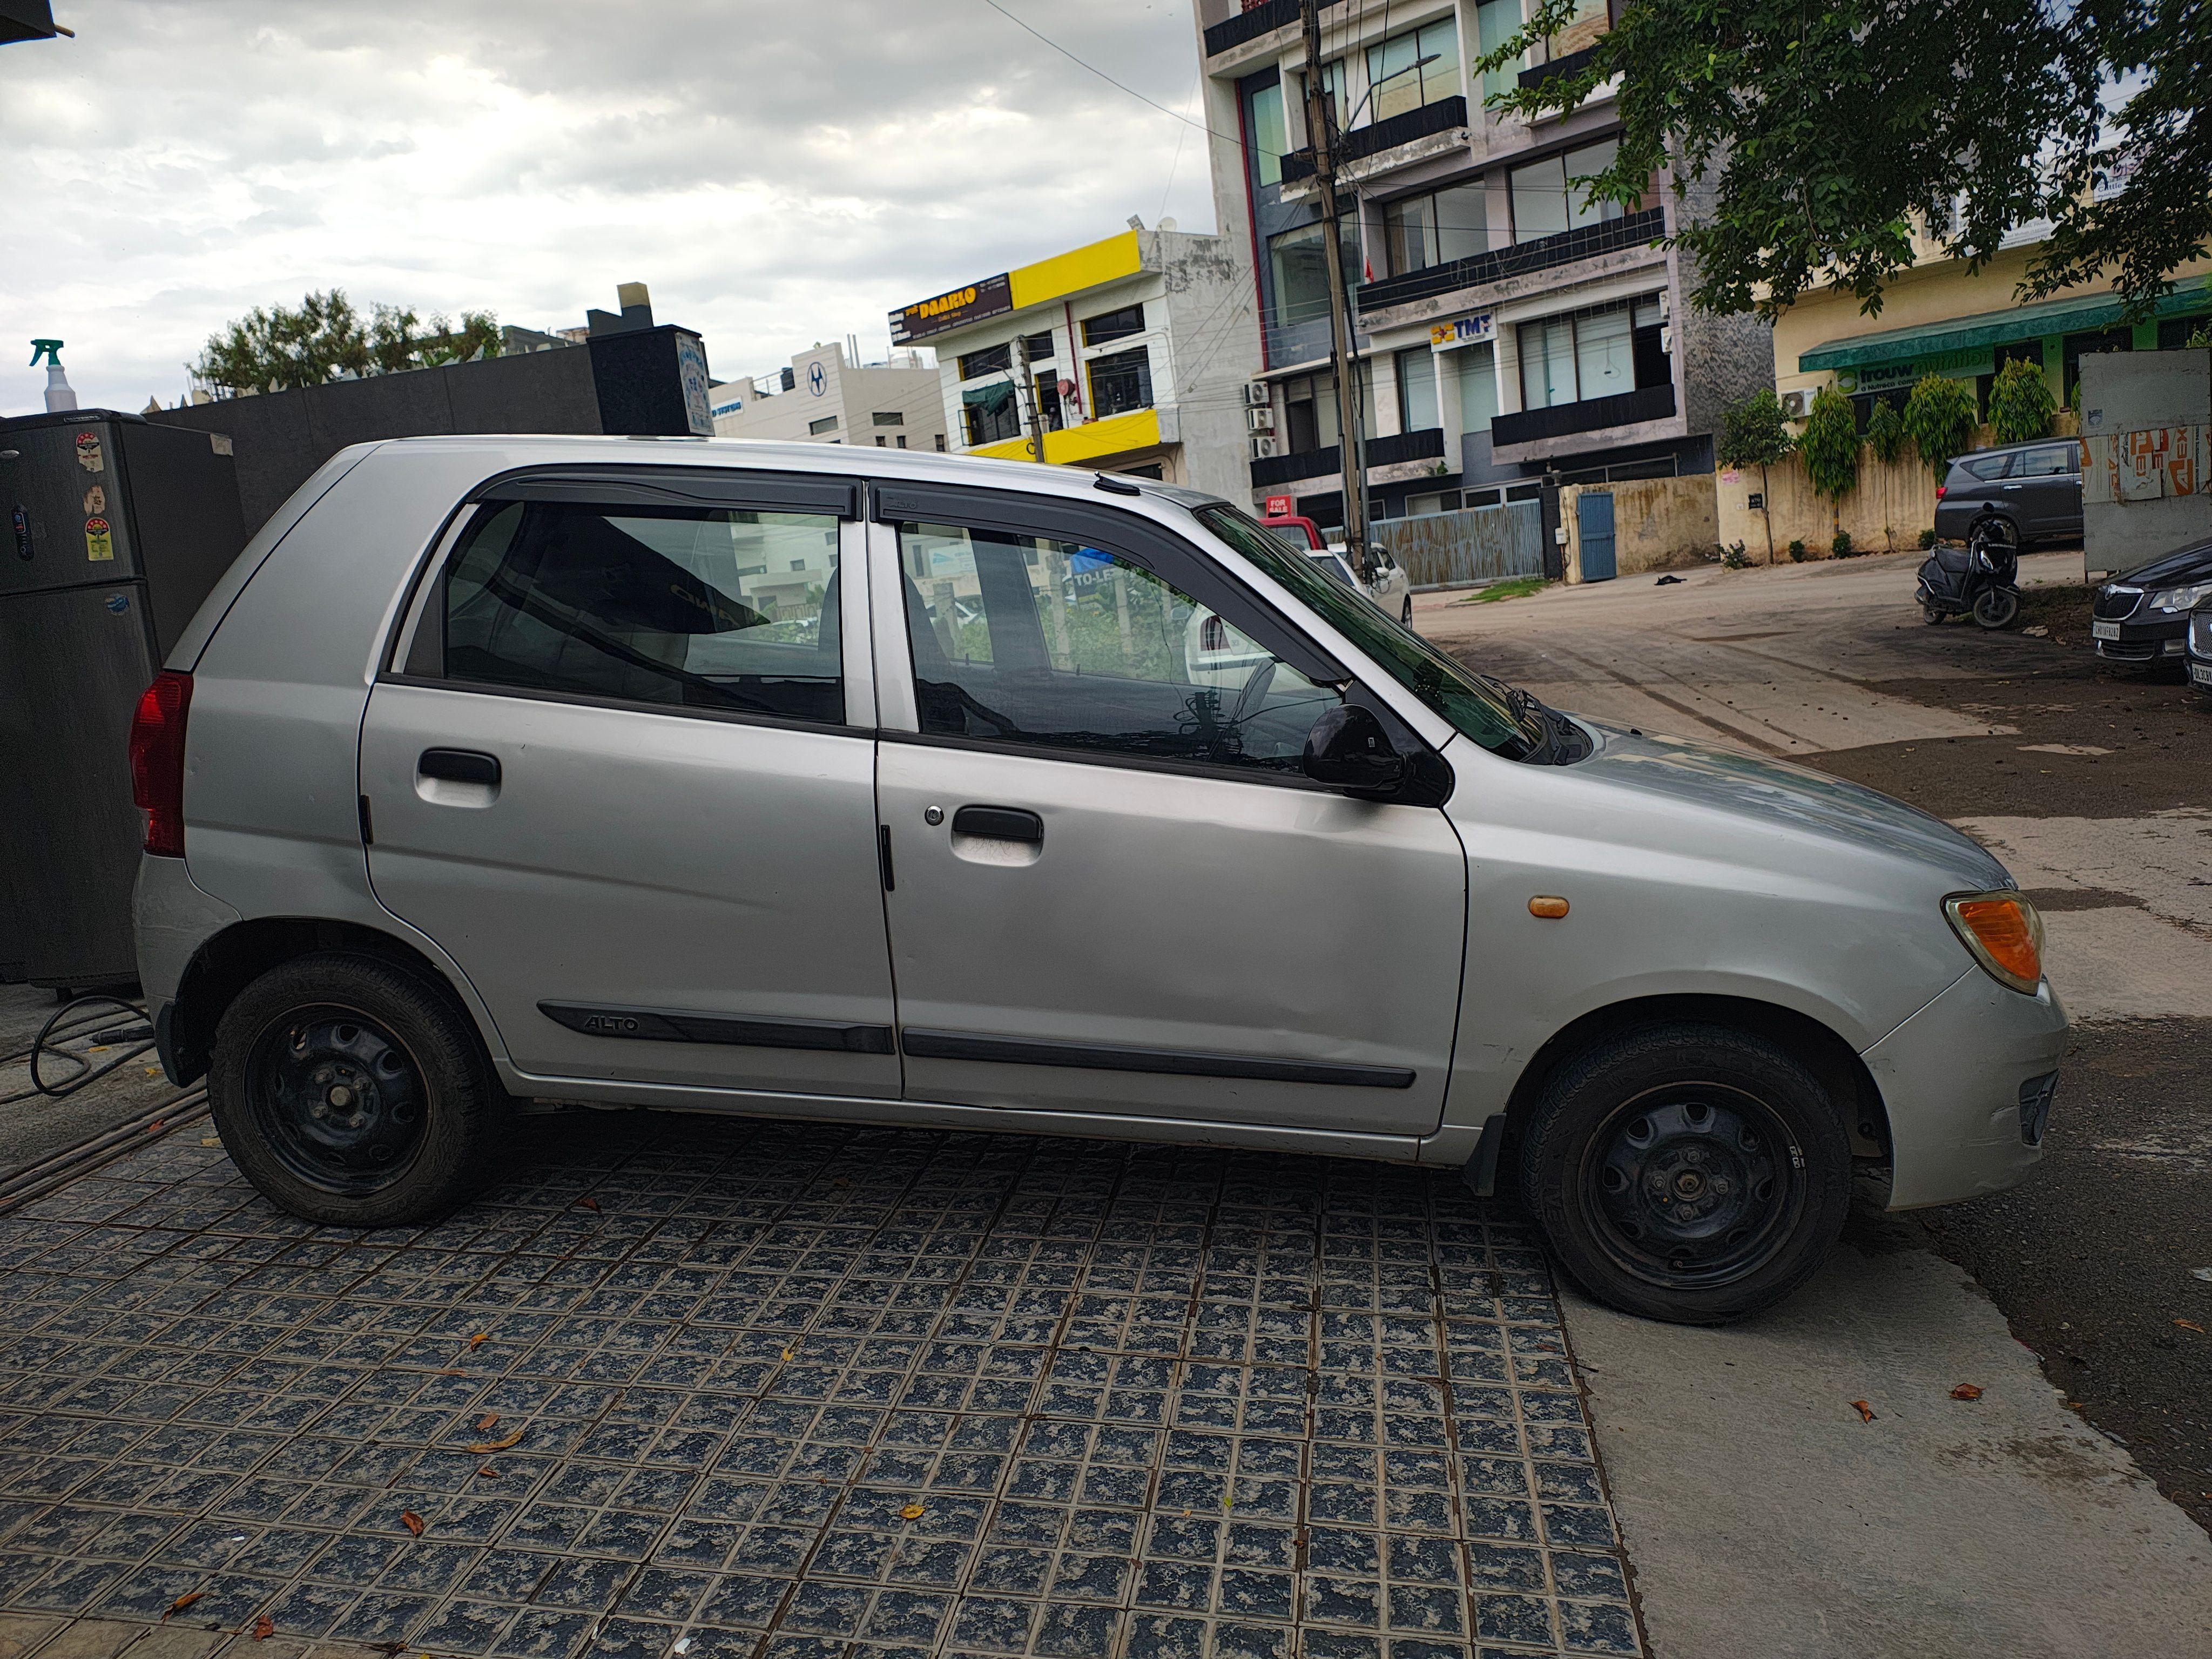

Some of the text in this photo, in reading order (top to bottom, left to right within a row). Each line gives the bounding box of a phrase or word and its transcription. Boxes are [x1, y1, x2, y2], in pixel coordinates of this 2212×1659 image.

[1860, 363, 1913, 383] trouw
[1270, 499, 1286, 507] FOR
[1074, 568, 1117, 586] TO-LE
[584, 1015, 640, 1032] ALTO
